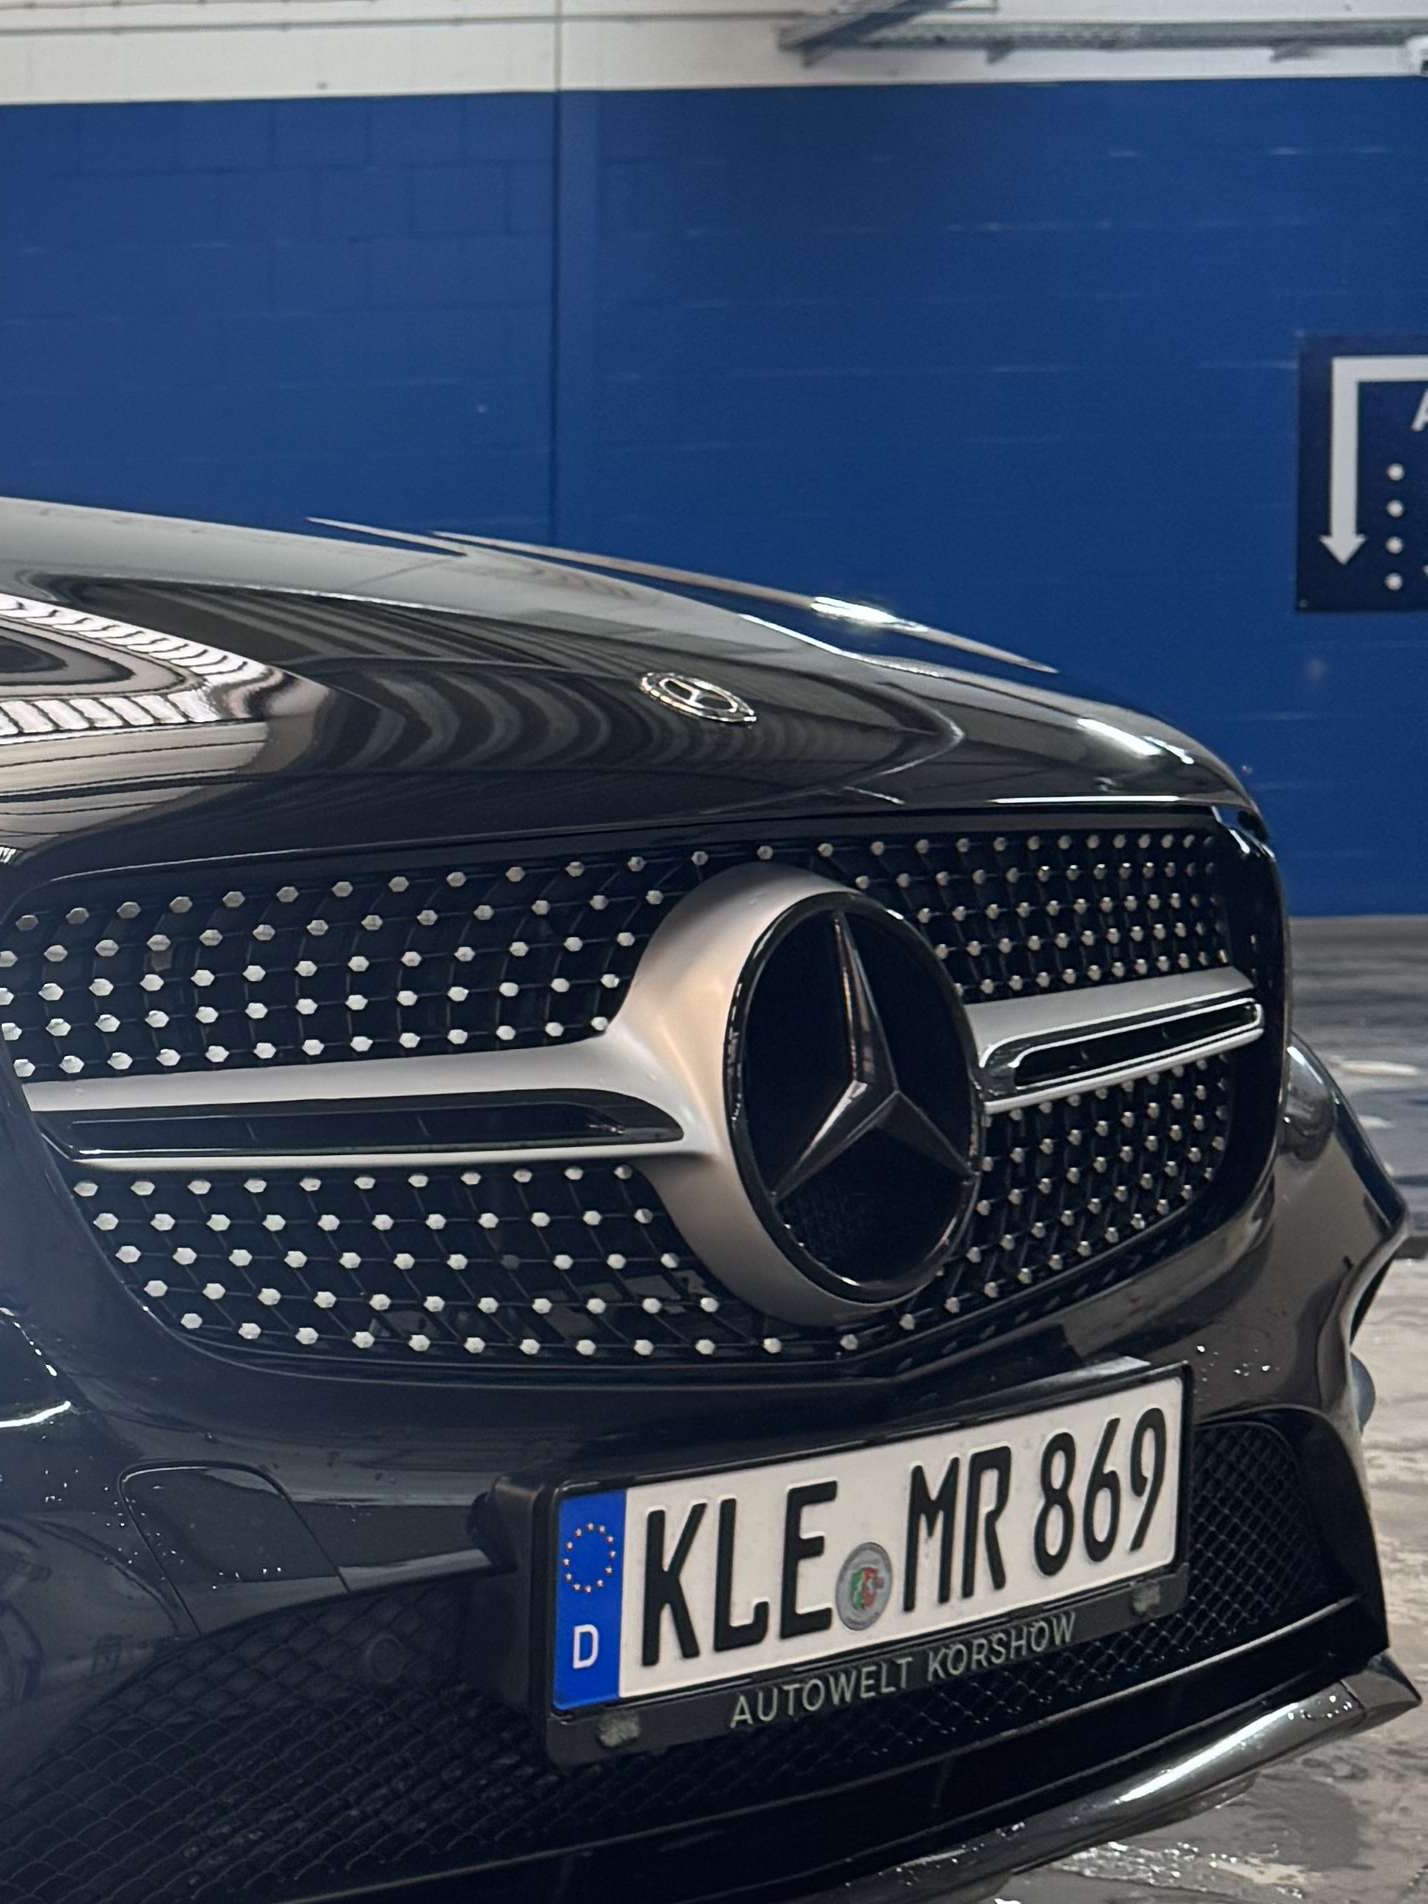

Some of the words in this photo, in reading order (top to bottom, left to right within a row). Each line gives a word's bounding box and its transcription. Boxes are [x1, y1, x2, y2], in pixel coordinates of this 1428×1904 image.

[641, 1480, 839, 1667] KLE
[902, 1445, 1013, 1613] MR
[1034, 1407, 1168, 1577] 869
[572, 1624, 599, 1670] D
[730, 1655, 914, 1730] AUTOWELT
[927, 1611, 1077, 1681] KORSHOW
